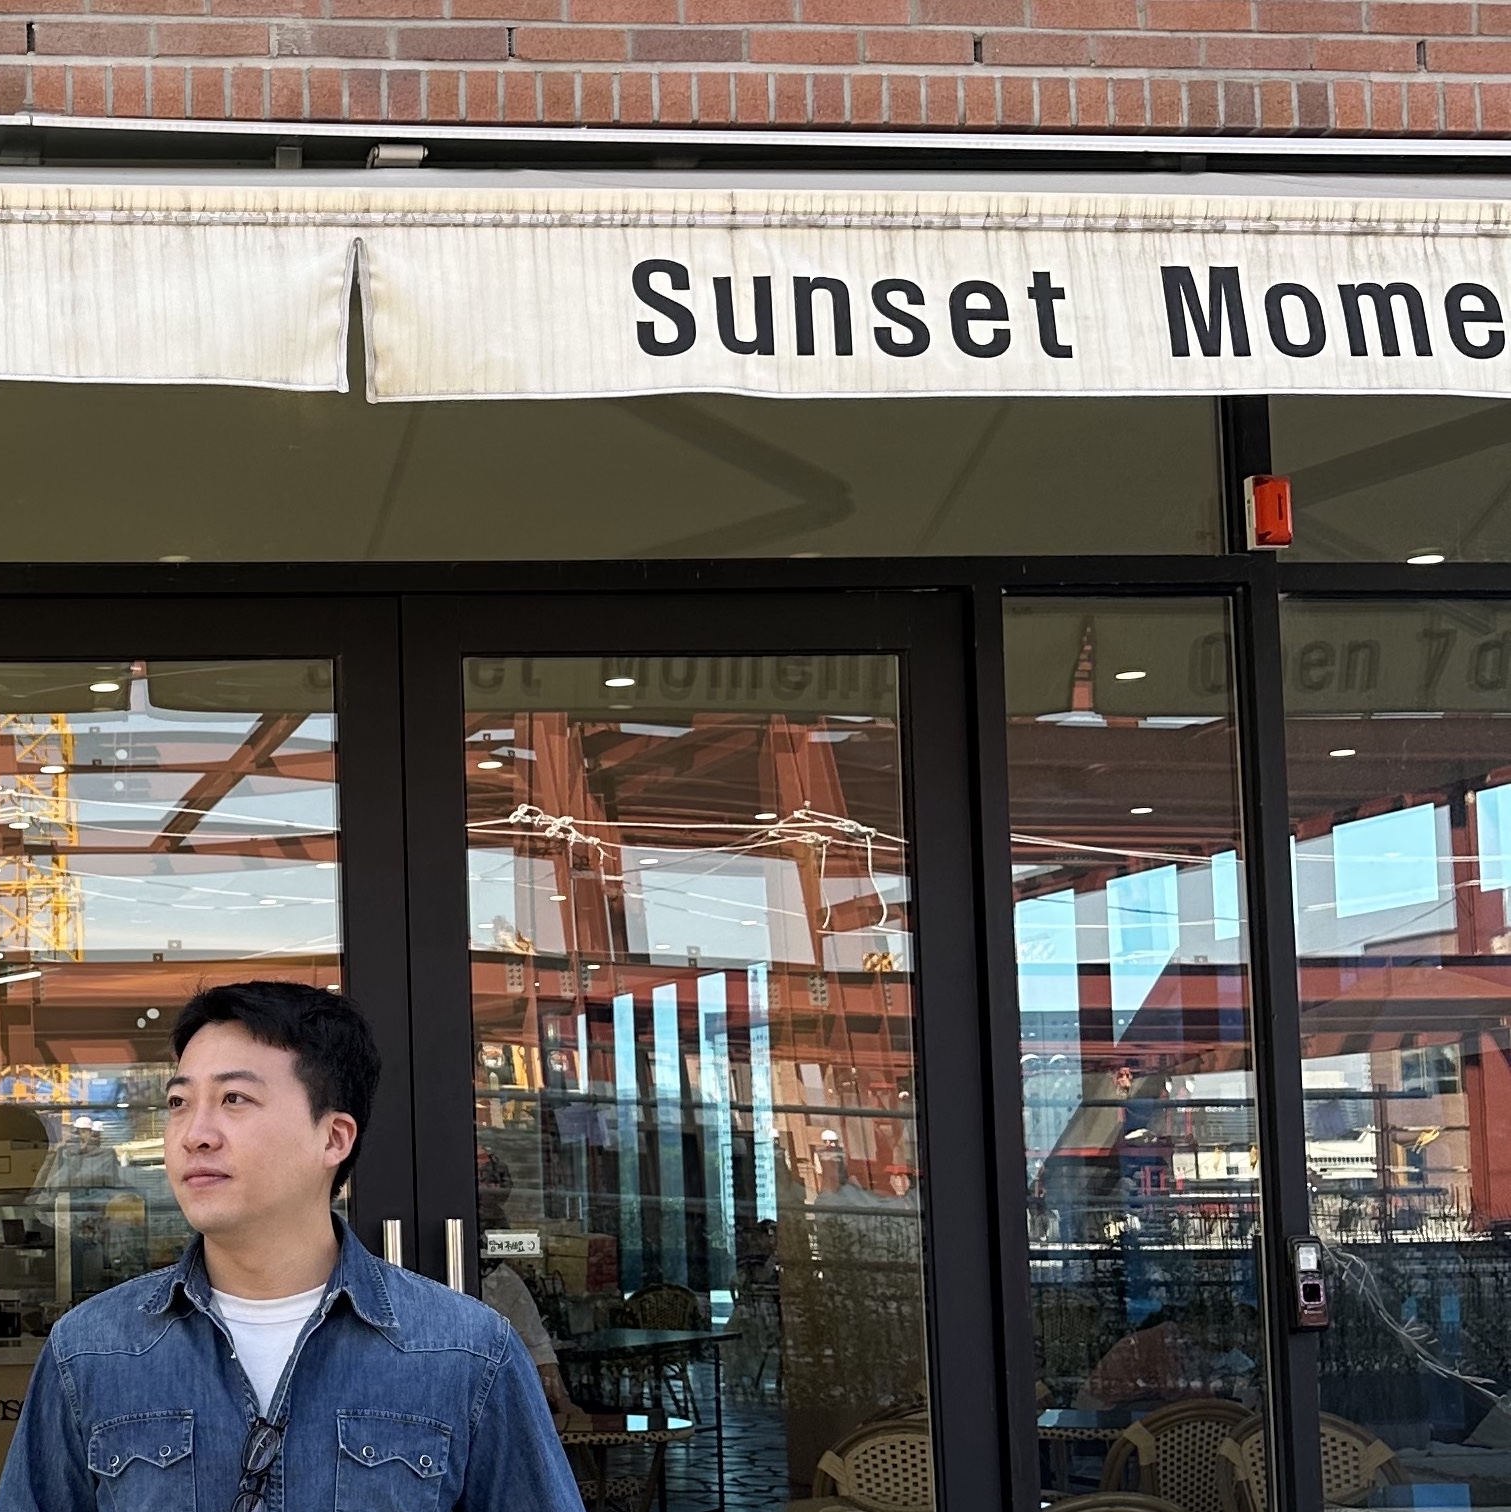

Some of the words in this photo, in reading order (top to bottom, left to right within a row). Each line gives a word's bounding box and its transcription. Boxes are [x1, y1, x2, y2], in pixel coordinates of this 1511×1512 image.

[632, 259, 1073, 358] Sunset
[1162, 265, 1506, 359] Mome
[1187, 631, 1381, 695] Oen
